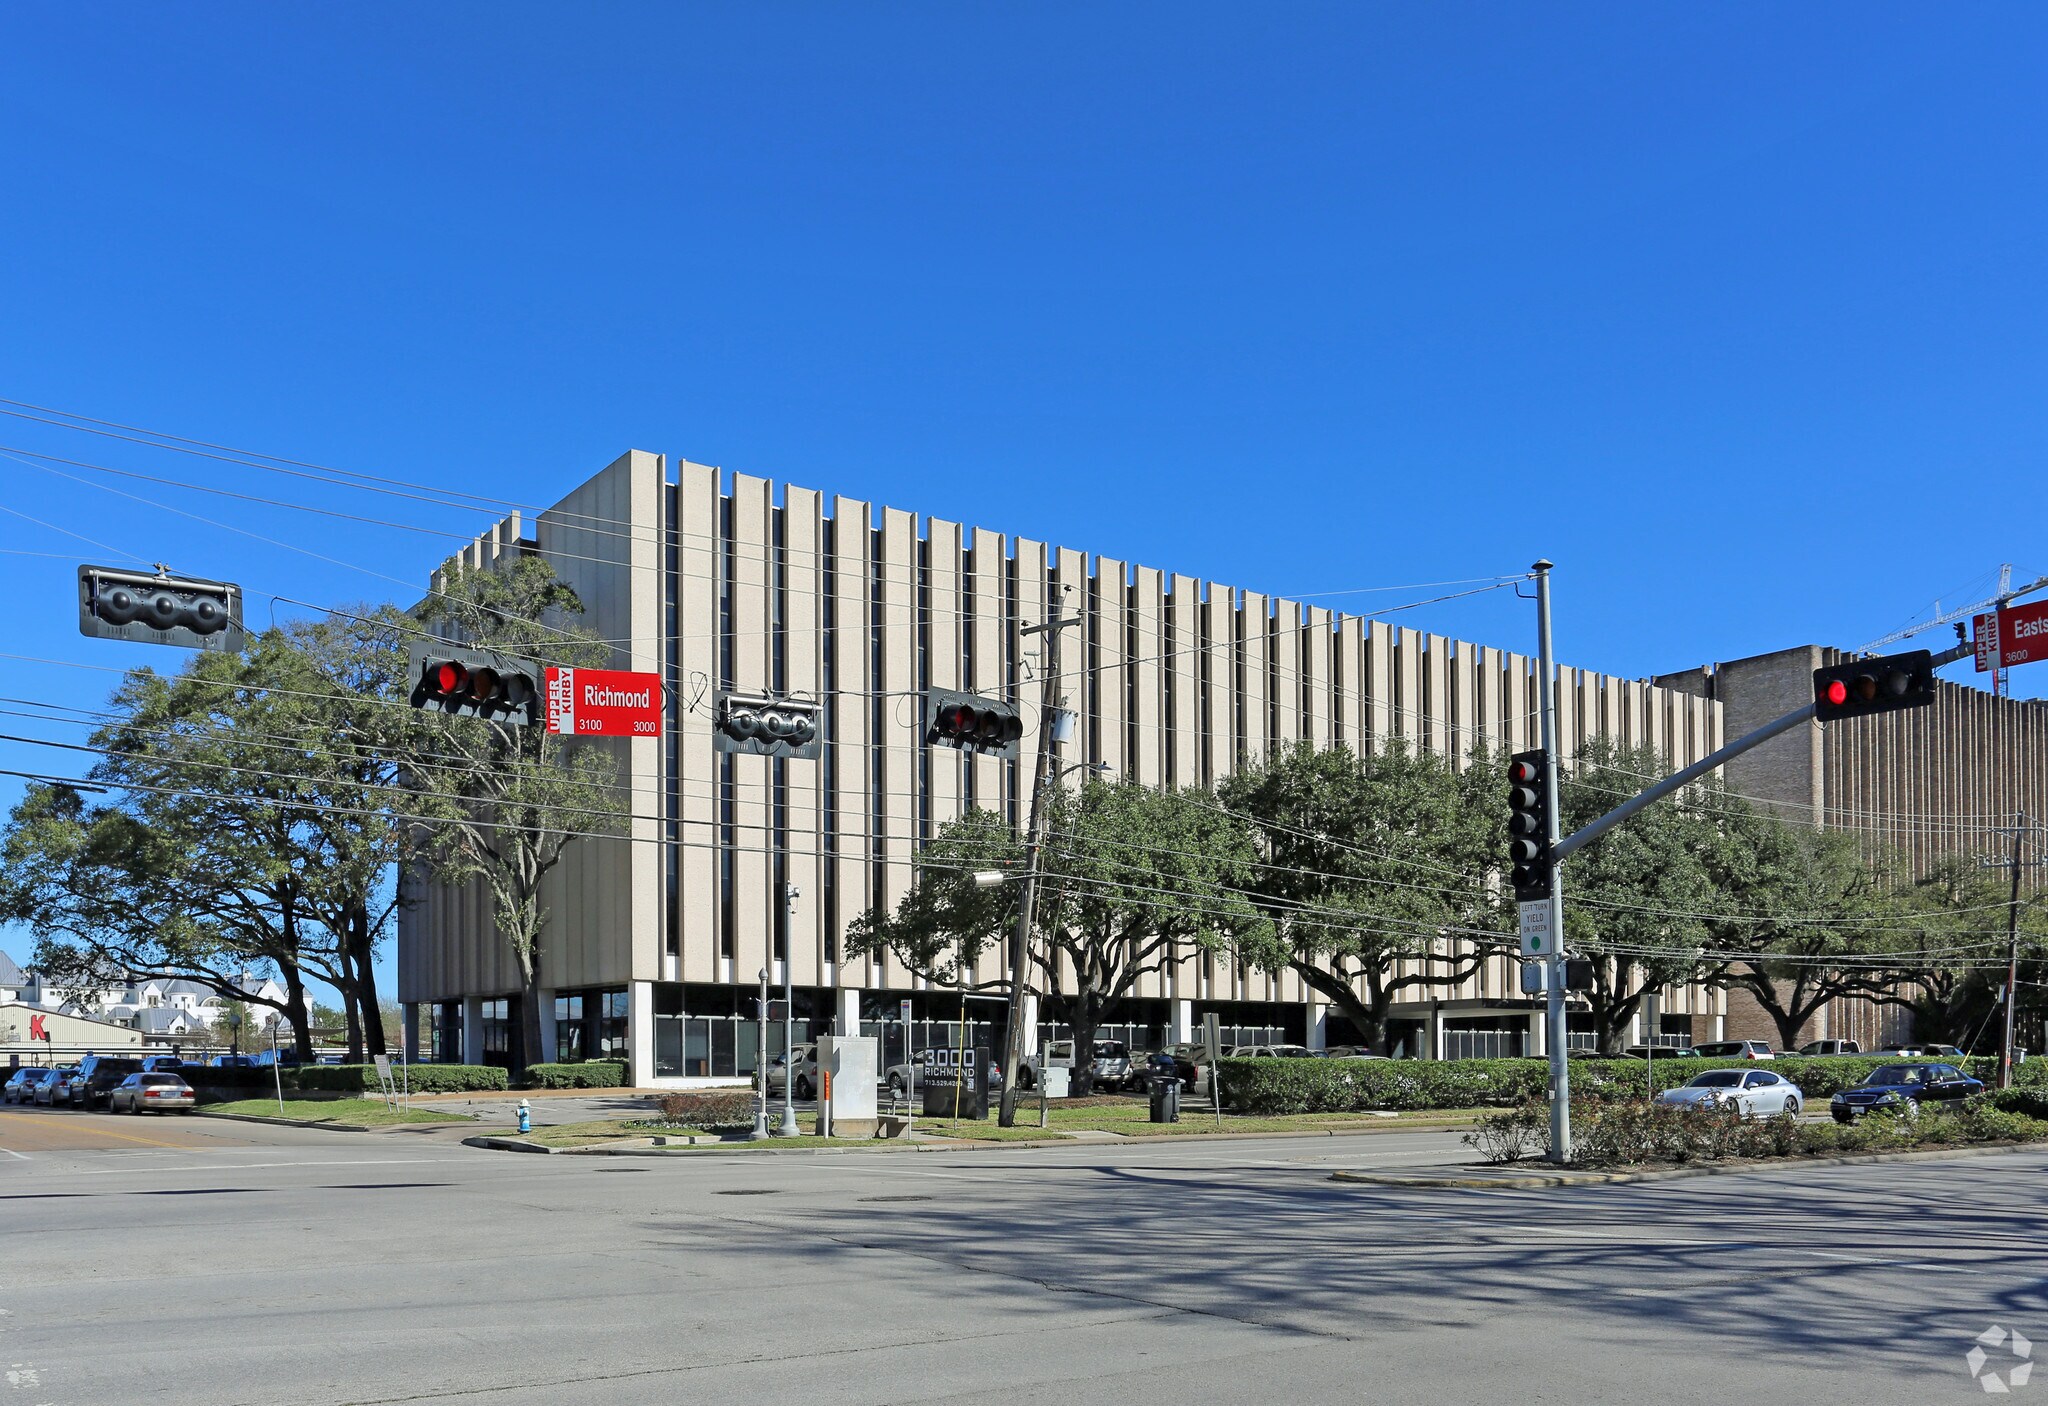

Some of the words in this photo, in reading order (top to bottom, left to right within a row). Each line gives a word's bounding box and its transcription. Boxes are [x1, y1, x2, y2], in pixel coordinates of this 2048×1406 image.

[1987, 614, 1997, 652] KIRBY
[2014, 616, 2048, 639] Easts
[1976, 624, 1987, 669] UPPER
[2005, 649, 2028, 662] 3600
[561, 670, 571, 713] KIRBY
[585, 685, 650, 708] Richmond
[549, 679, 560, 730] UPPER
[579, 719, 602, 731] 3100
[633, 721, 656, 732] 3000
[1521, 904, 1533, 912] LEFT
[1534, 903, 1548, 911] TURN
[1526, 913, 1544, 923] YIELD
[1532, 925, 1547, 933] GREEN
[31, 1014, 46, 1040] K
[925, 1049, 975, 1067] 3000
[924, 1067, 975, 1078] RICHMOND
